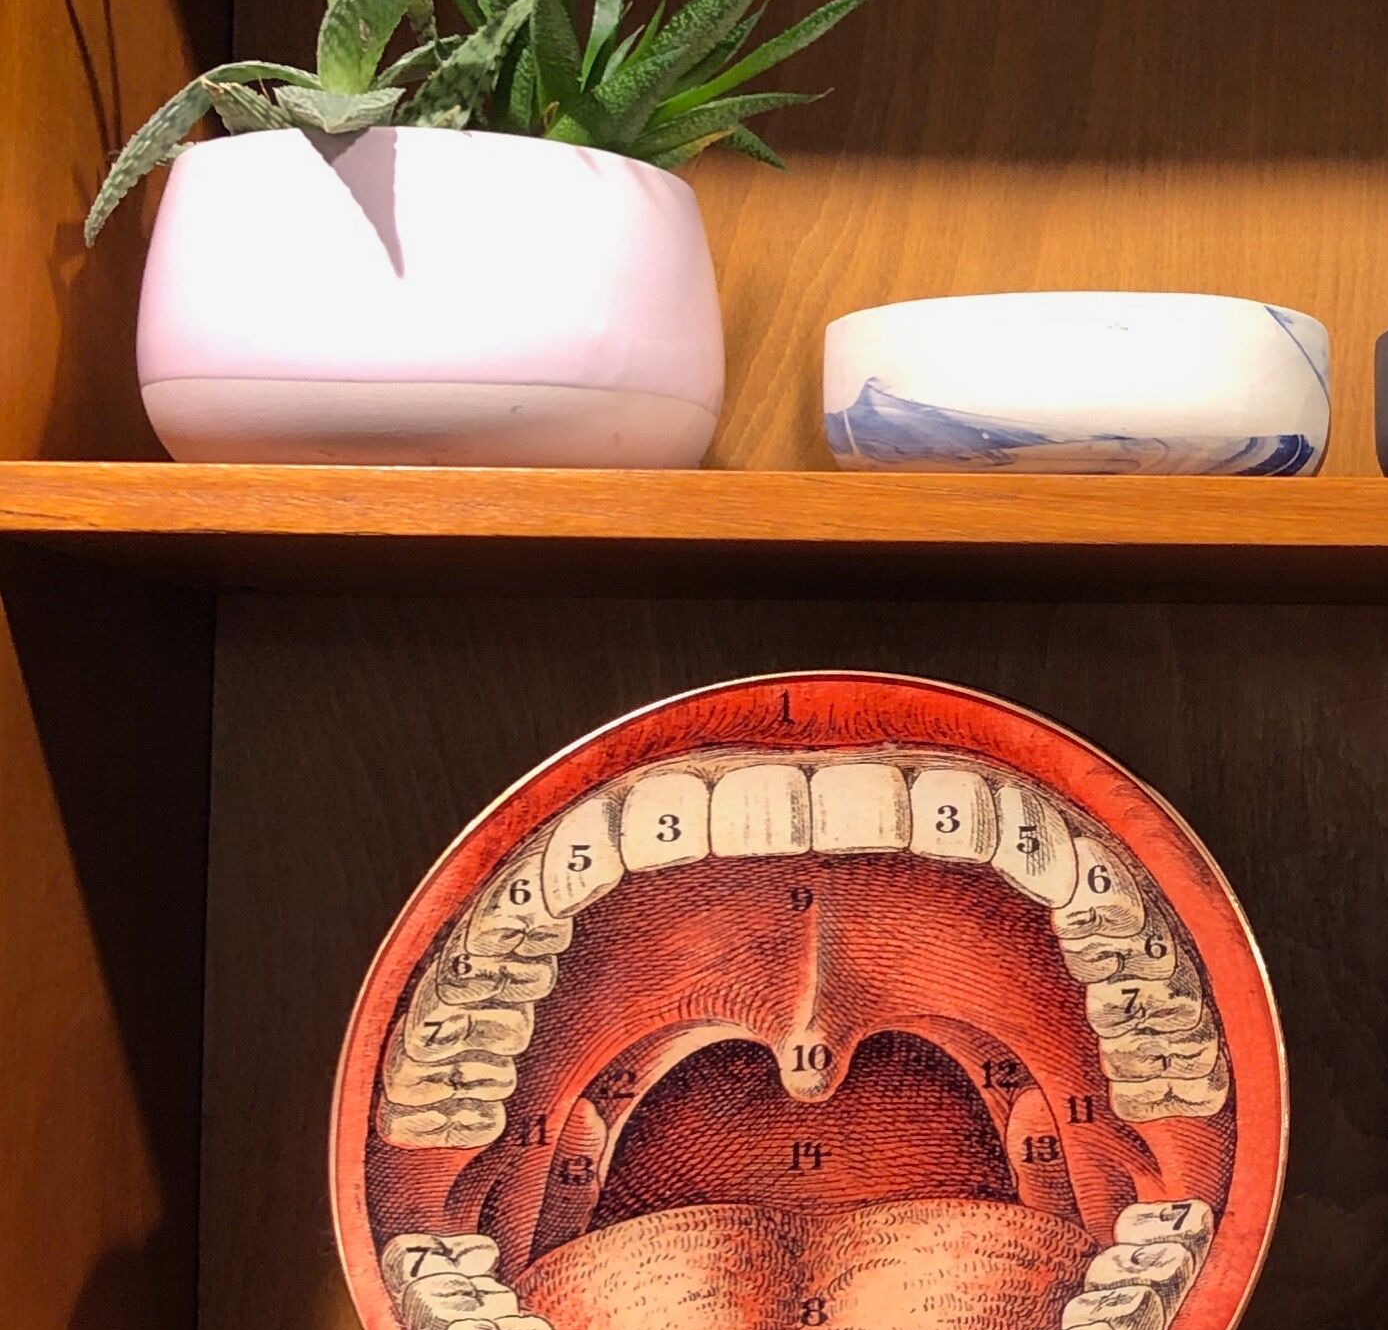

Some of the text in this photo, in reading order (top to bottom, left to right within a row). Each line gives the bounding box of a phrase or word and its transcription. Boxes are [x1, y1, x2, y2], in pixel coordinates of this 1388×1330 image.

[777, 691, 795, 725] 1
[656, 813, 682, 843] 3
[936, 805, 960, 834] 3
[1016, 825, 1040, 855] 5
[566, 844, 592, 873] 5
[508, 878, 531, 907] 6
[1087, 865, 1112, 895] 6
[788, 889, 814, 913] 9
[1144, 935, 1167, 959] 6
[451, 953, 473, 976] 6
[1121, 988, 1141, 1015] 7
[424, 1021, 444, 1048] 7
[791, 1043, 833, 1073] 10
[981, 1060, 1020, 1090] 12
[1067, 1095, 1096, 1124] 11
[785, 1139, 831, 1173] 14
[1021, 1135, 1061, 1164] 13
[1171, 1203, 1192, 1231] 7
[405, 1246, 429, 1278] 7
[799, 1296, 828, 1328] 8
